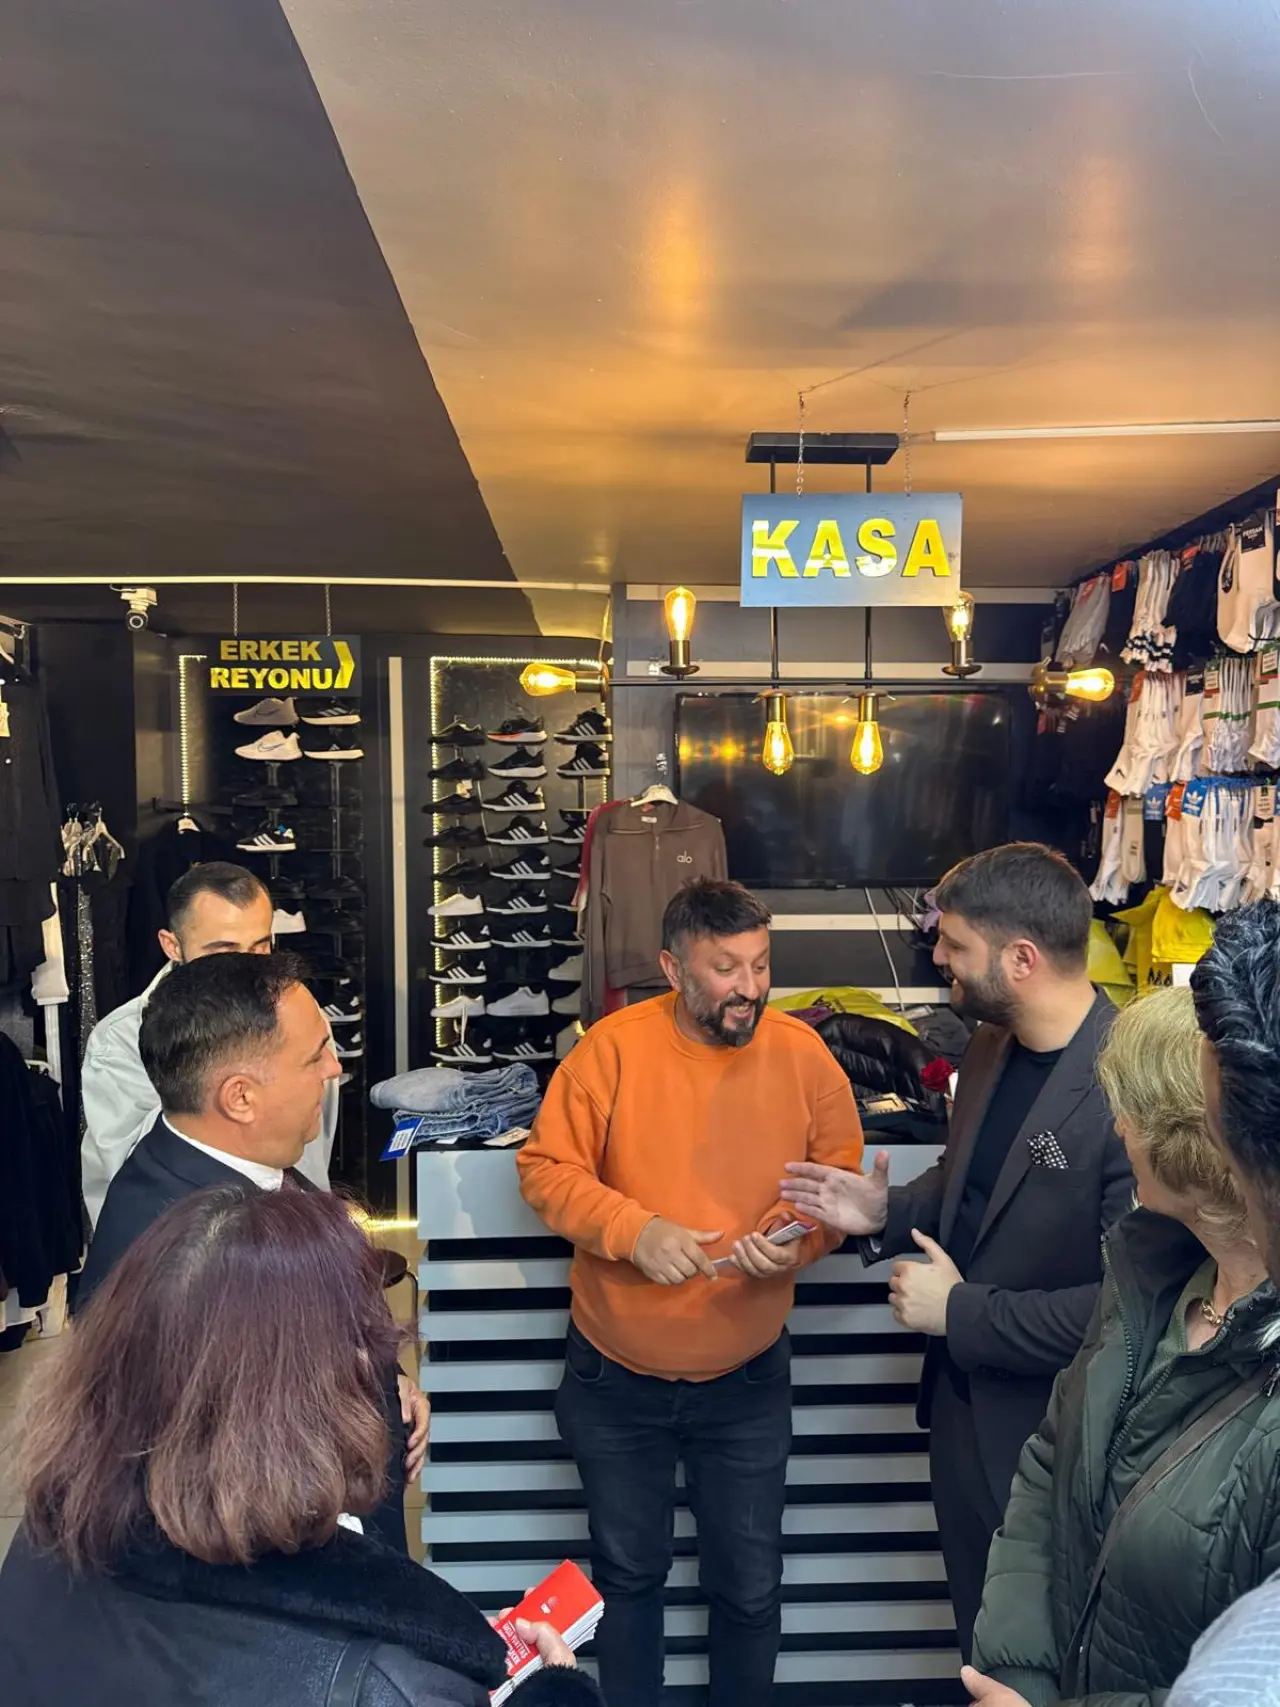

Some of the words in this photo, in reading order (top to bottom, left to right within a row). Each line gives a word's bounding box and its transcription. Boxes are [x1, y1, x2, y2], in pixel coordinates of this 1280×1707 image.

[751, 517, 952, 578] KASA
[220, 639, 323, 661] ERKEK
[210, 667, 333, 690] REYONU
[676, 849, 693, 864] alo
